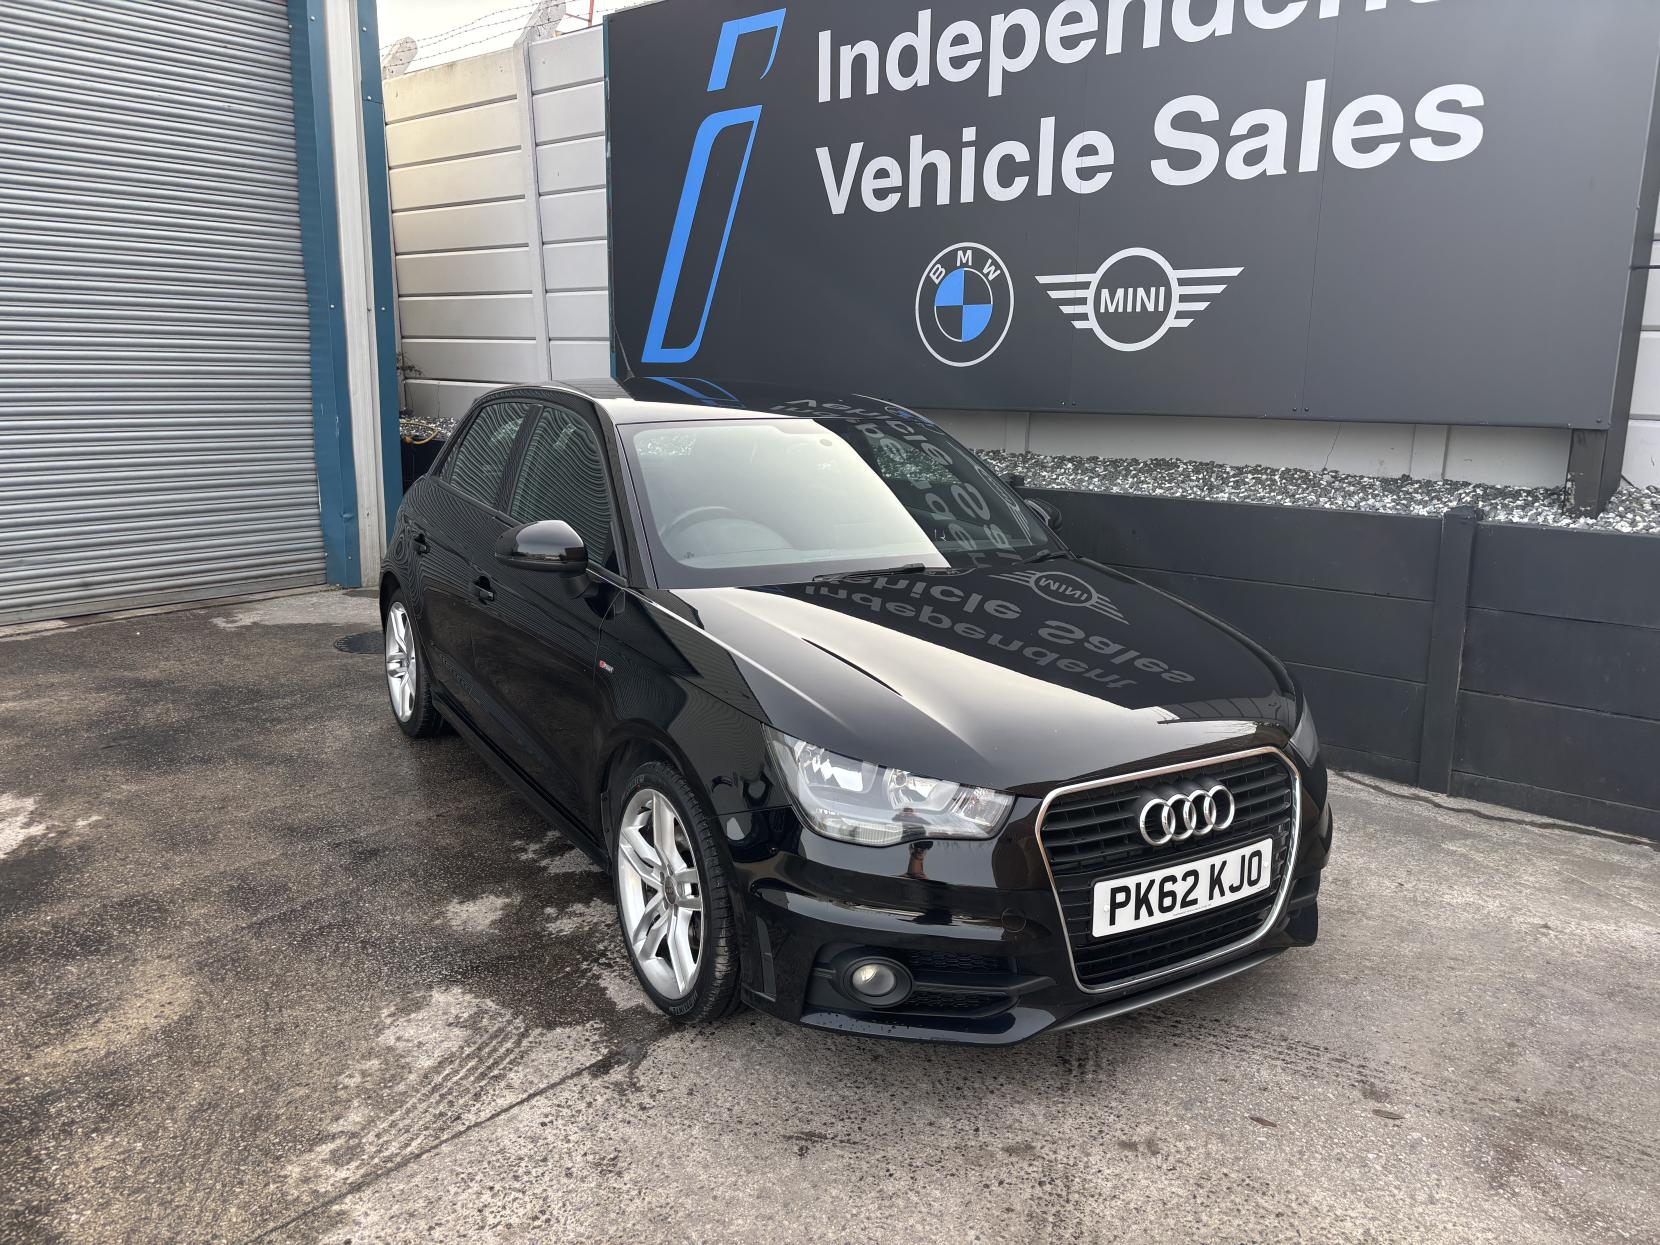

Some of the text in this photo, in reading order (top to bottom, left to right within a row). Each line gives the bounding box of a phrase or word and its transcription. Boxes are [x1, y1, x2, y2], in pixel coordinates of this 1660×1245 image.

[818, 0, 1439, 103] Indepen
[815, 78, 1485, 215] Vehicle Sales
[929, 249, 1001, 285] BMW
[1099, 286, 1166, 313] MINI
[1109, 849, 1263, 927] PK62 KJO
